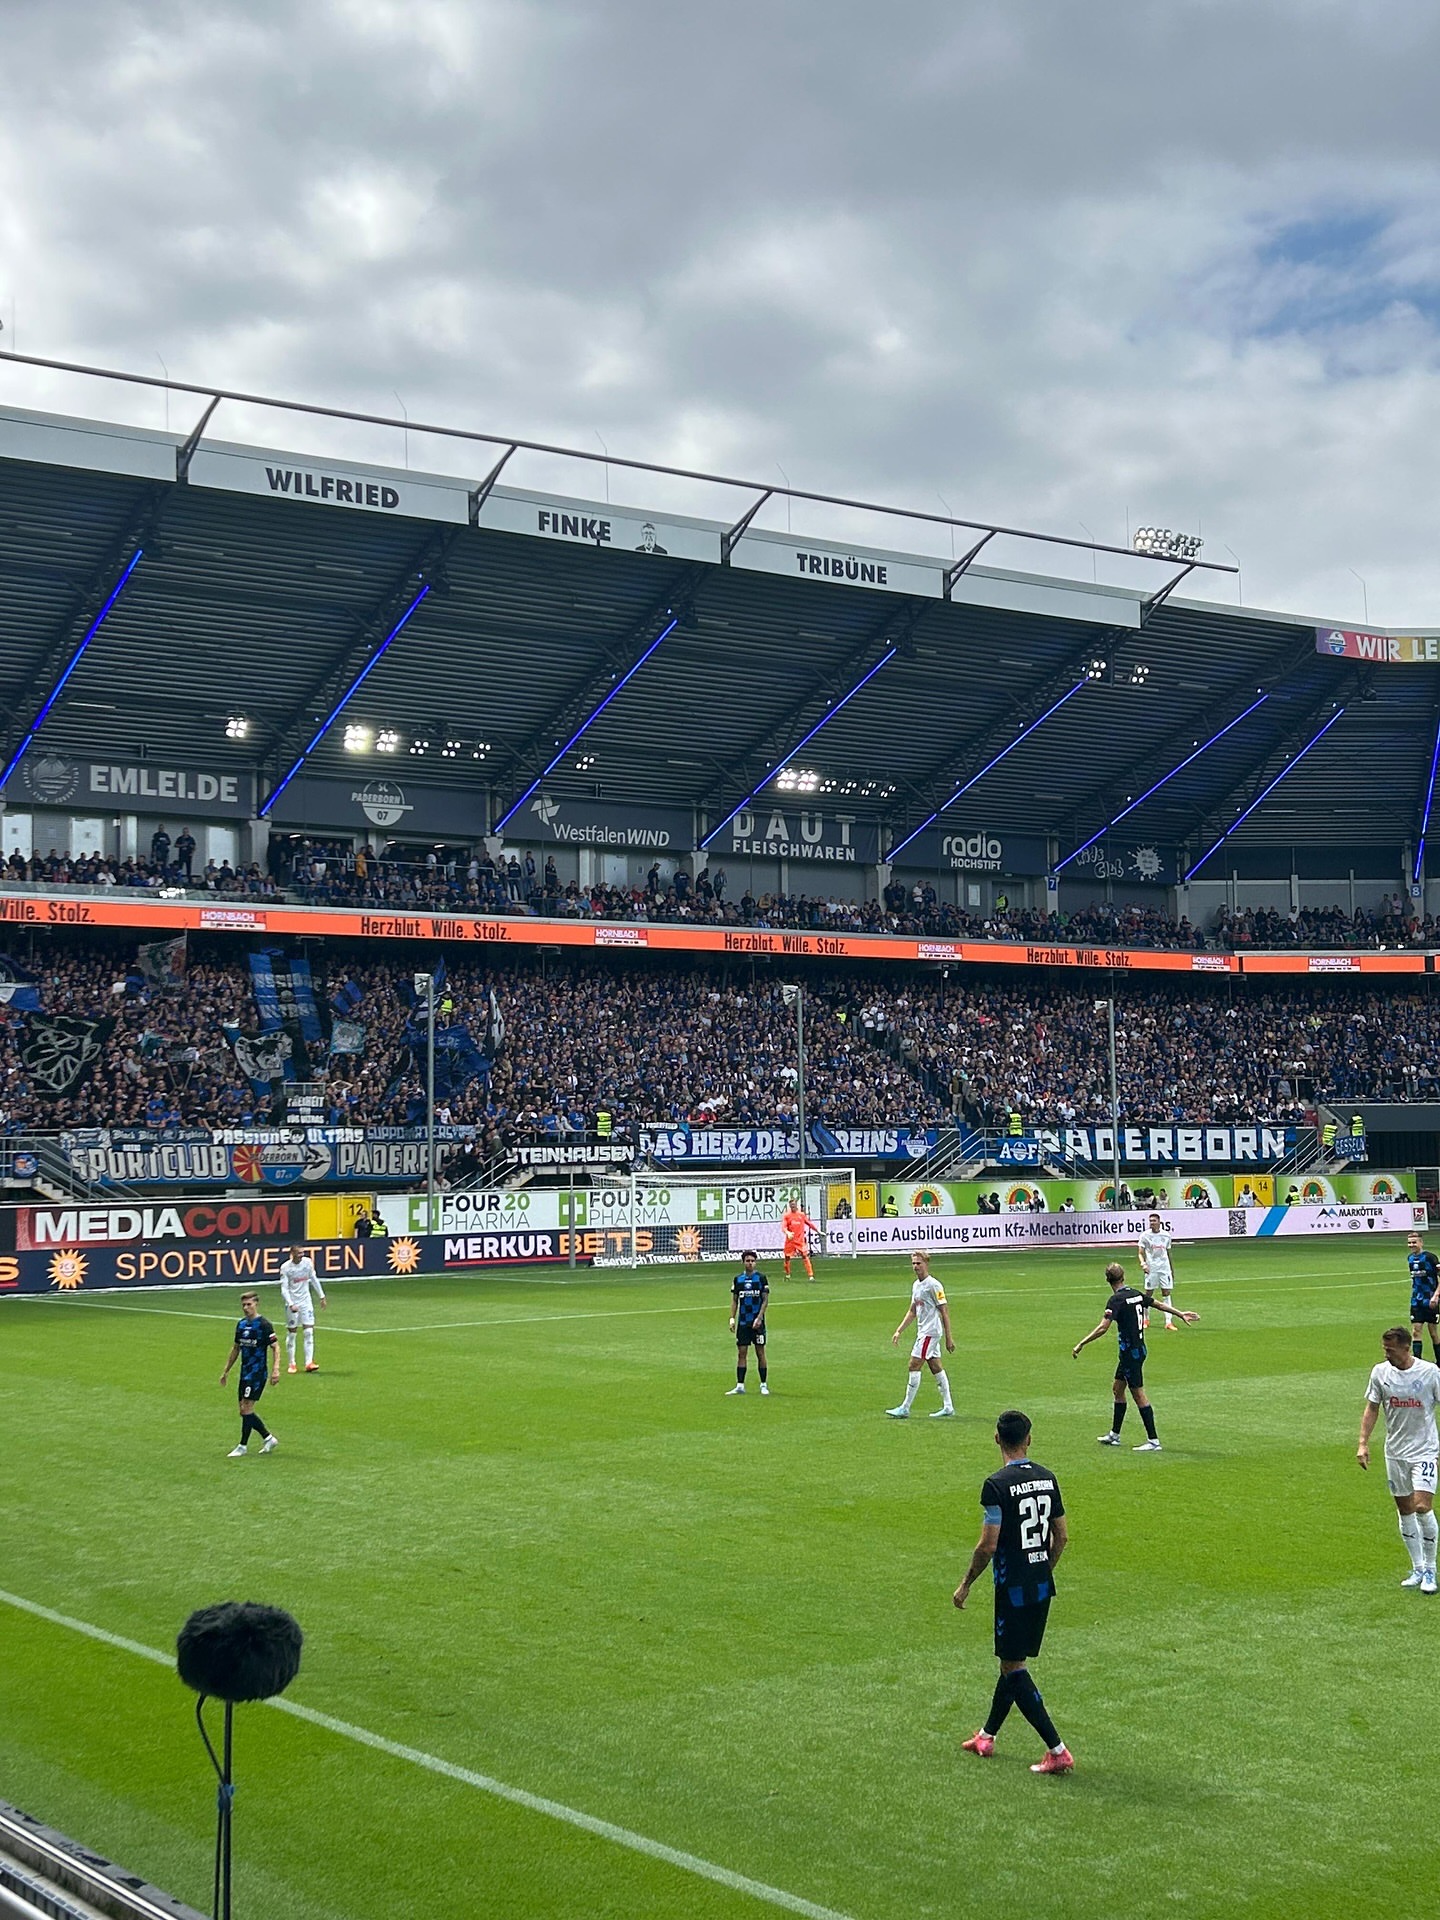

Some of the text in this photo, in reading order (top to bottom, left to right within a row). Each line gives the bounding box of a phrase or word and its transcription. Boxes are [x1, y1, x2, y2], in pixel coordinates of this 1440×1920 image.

[265, 467, 400, 509] WILFRIED
[538, 510, 611, 542] FINKE
[796, 552, 888, 585] TRIBÜNE
[90, 764, 239, 803] EMLEI.DE
[351, 792, 401, 804] PADERBORN
[376, 810, 389, 820] 07
[552, 823, 670, 847] WestfalenWIND
[732, 839, 856, 861] FLEISCHWAREN
[942, 834, 1002, 857] radio
[950, 858, 1002, 870] HOCHSTIFT
[1049, 878, 1056, 889] 7
[1412, 886, 1422, 897] 8
[48, 902, 96, 923] Stolz.
[201, 911, 255, 921] HORNBACH
[361, 917, 512, 940] Herzblut. Wille. Stolz.
[596, 928, 639, 938] HORNBACH
[724, 933, 849, 954] Herzblut. Wille. Stolz.
[918, 943, 955, 953] HORNBACH
[1027, 948, 1133, 967] Herzblut. Wille. Stolz.
[1309, 957, 1351, 966] HORNBACH
[307, 1127, 364, 1144] ULTRAS
[692, 1131, 752, 1155] HERZ
[757, 1130, 800, 1153] DES
[725, 1186, 802, 1204] FOUR 20
[858, 1189, 870, 1201] 13
[1258, 1181, 1268, 1191] 14
[442, 1193, 531, 1212] FOUR 20
[589, 1189, 671, 1207] FOUR 20
[348, 1204, 364, 1216] 12
[589, 1207, 671, 1226] PHARMA
[914, 1207, 940, 1215] SUNLIFE
[1338, 1206, 1383, 1217] MARKÖTTER
[34, 1204, 290, 1243] MEDIACOM
[442, 1211, 531, 1232] PHARMA
[891, 1224, 970, 1242] Ausbildung
[972, 1226, 1001, 1239] zum
[1005, 1219, 1123, 1237] Kfz-Mechatroniker
[1127, 1219, 1146, 1233] bei
[444, 1231, 654, 1260] MERKUR BETS
[244, 1386, 252, 1398] 9
[1421, 1461, 1435, 1477] 22
